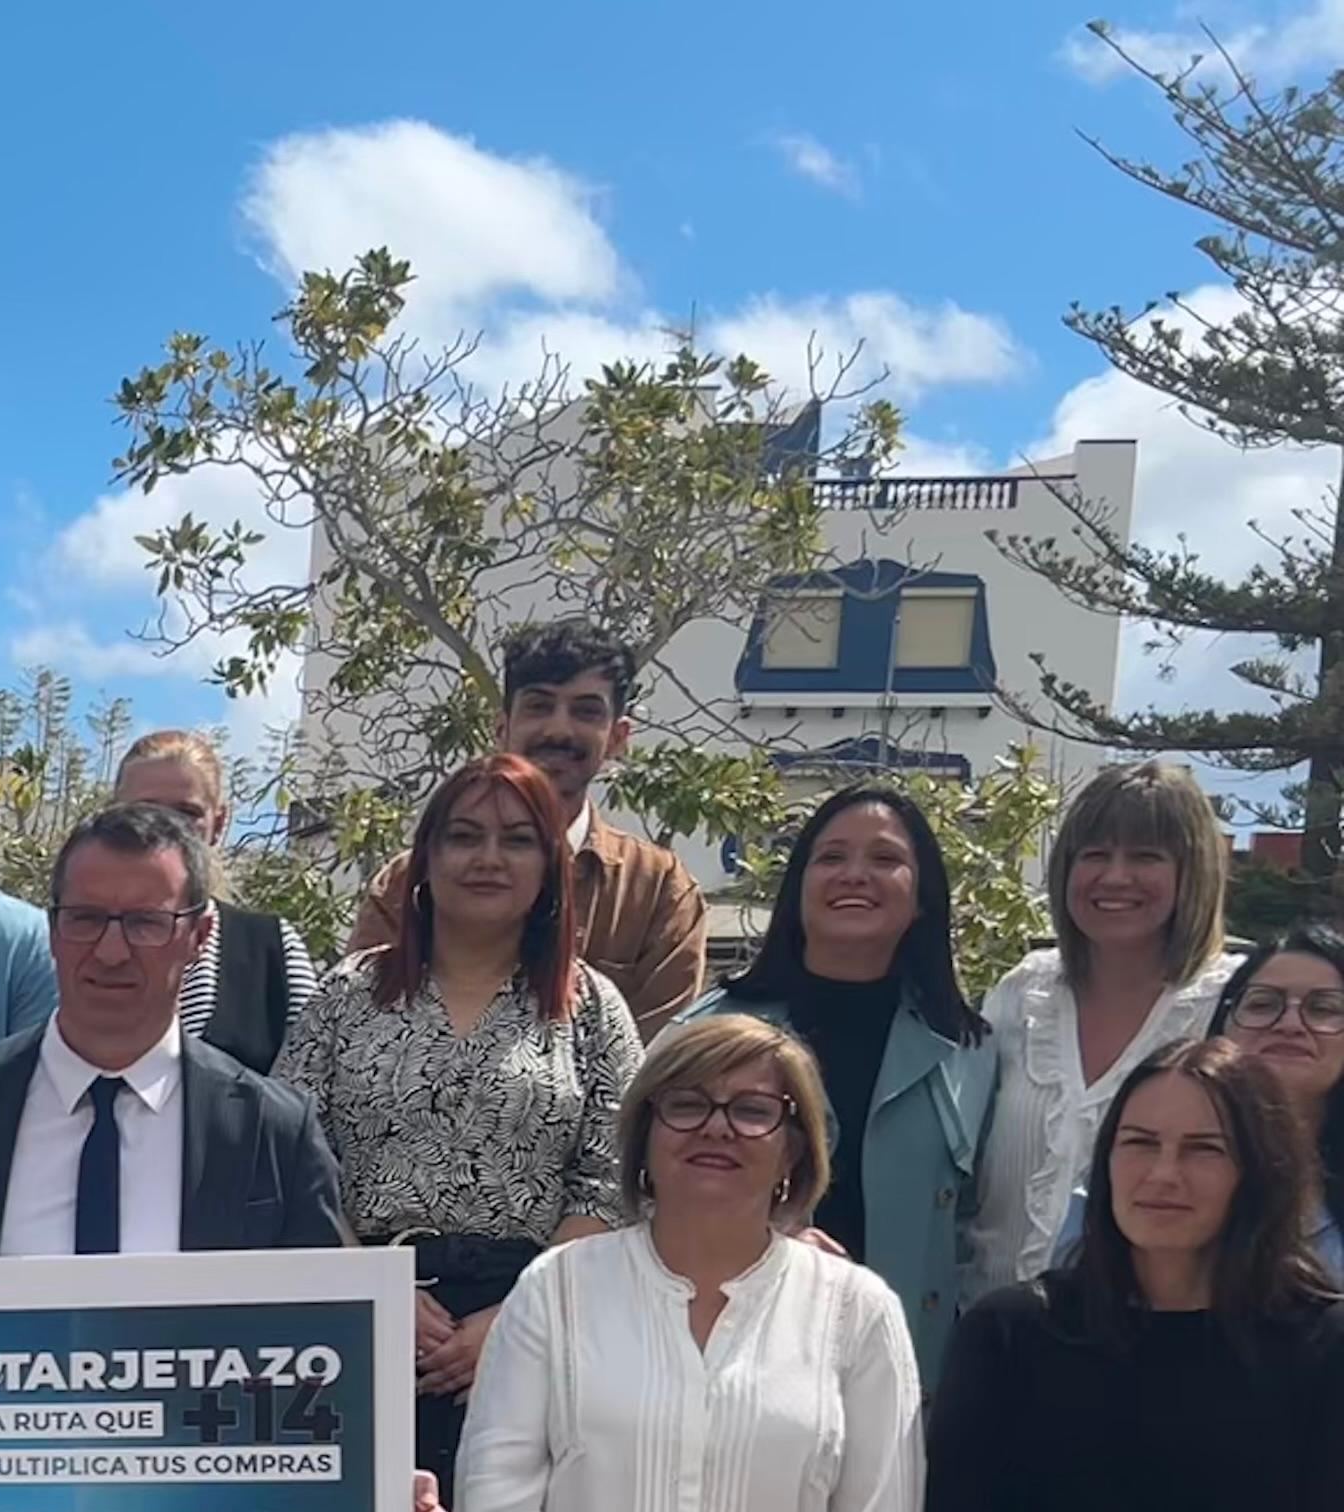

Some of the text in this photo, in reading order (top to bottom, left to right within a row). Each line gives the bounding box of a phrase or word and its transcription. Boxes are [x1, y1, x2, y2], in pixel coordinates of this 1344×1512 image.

[183, 1377, 341, 1442] +14
[14, 1412, 86, 1430] RUTA
[95, 1410, 153, 1432] QUE
[136, 1456, 186, 1474] TUS
[195, 1454, 332, 1474] COMPRAS
